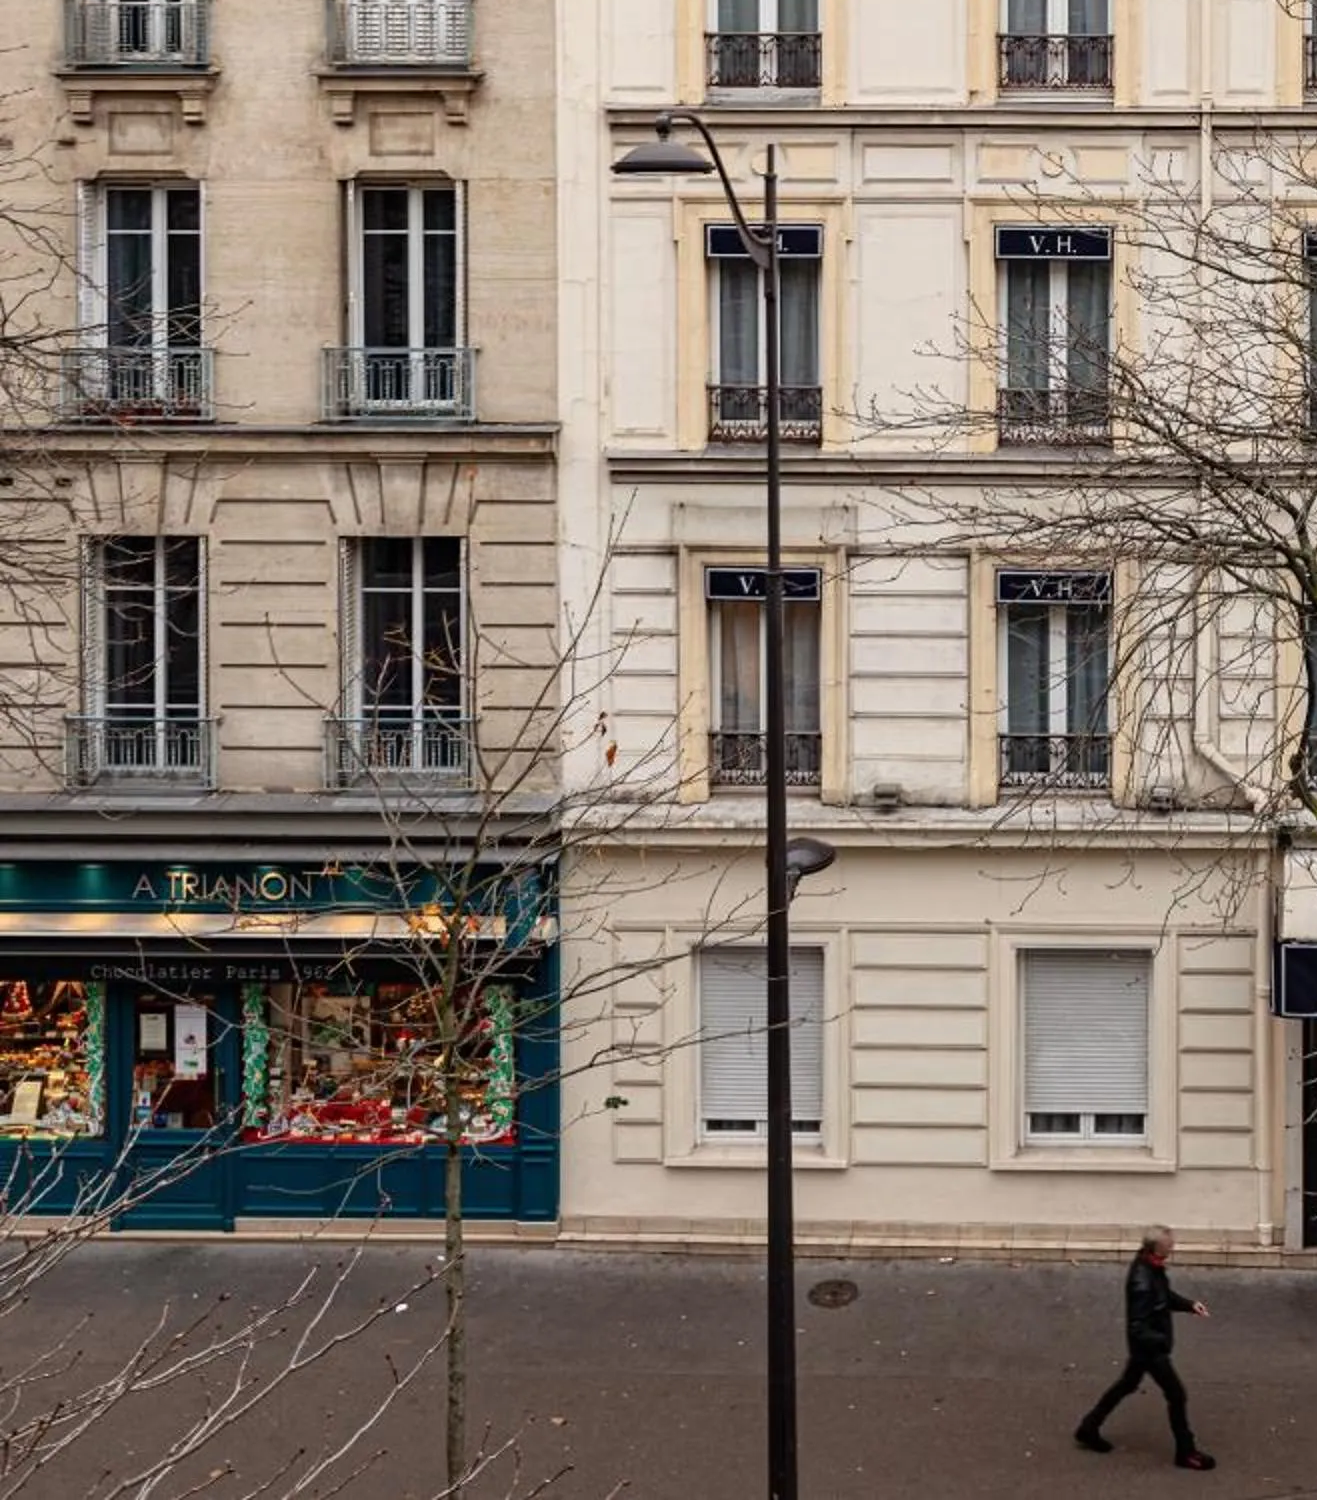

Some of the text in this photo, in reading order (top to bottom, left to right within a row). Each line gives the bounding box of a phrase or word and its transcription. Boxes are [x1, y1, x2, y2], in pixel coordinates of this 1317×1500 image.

[132, 871, 312, 901] A TRIANON
[226, 965, 280, 979] Paris
